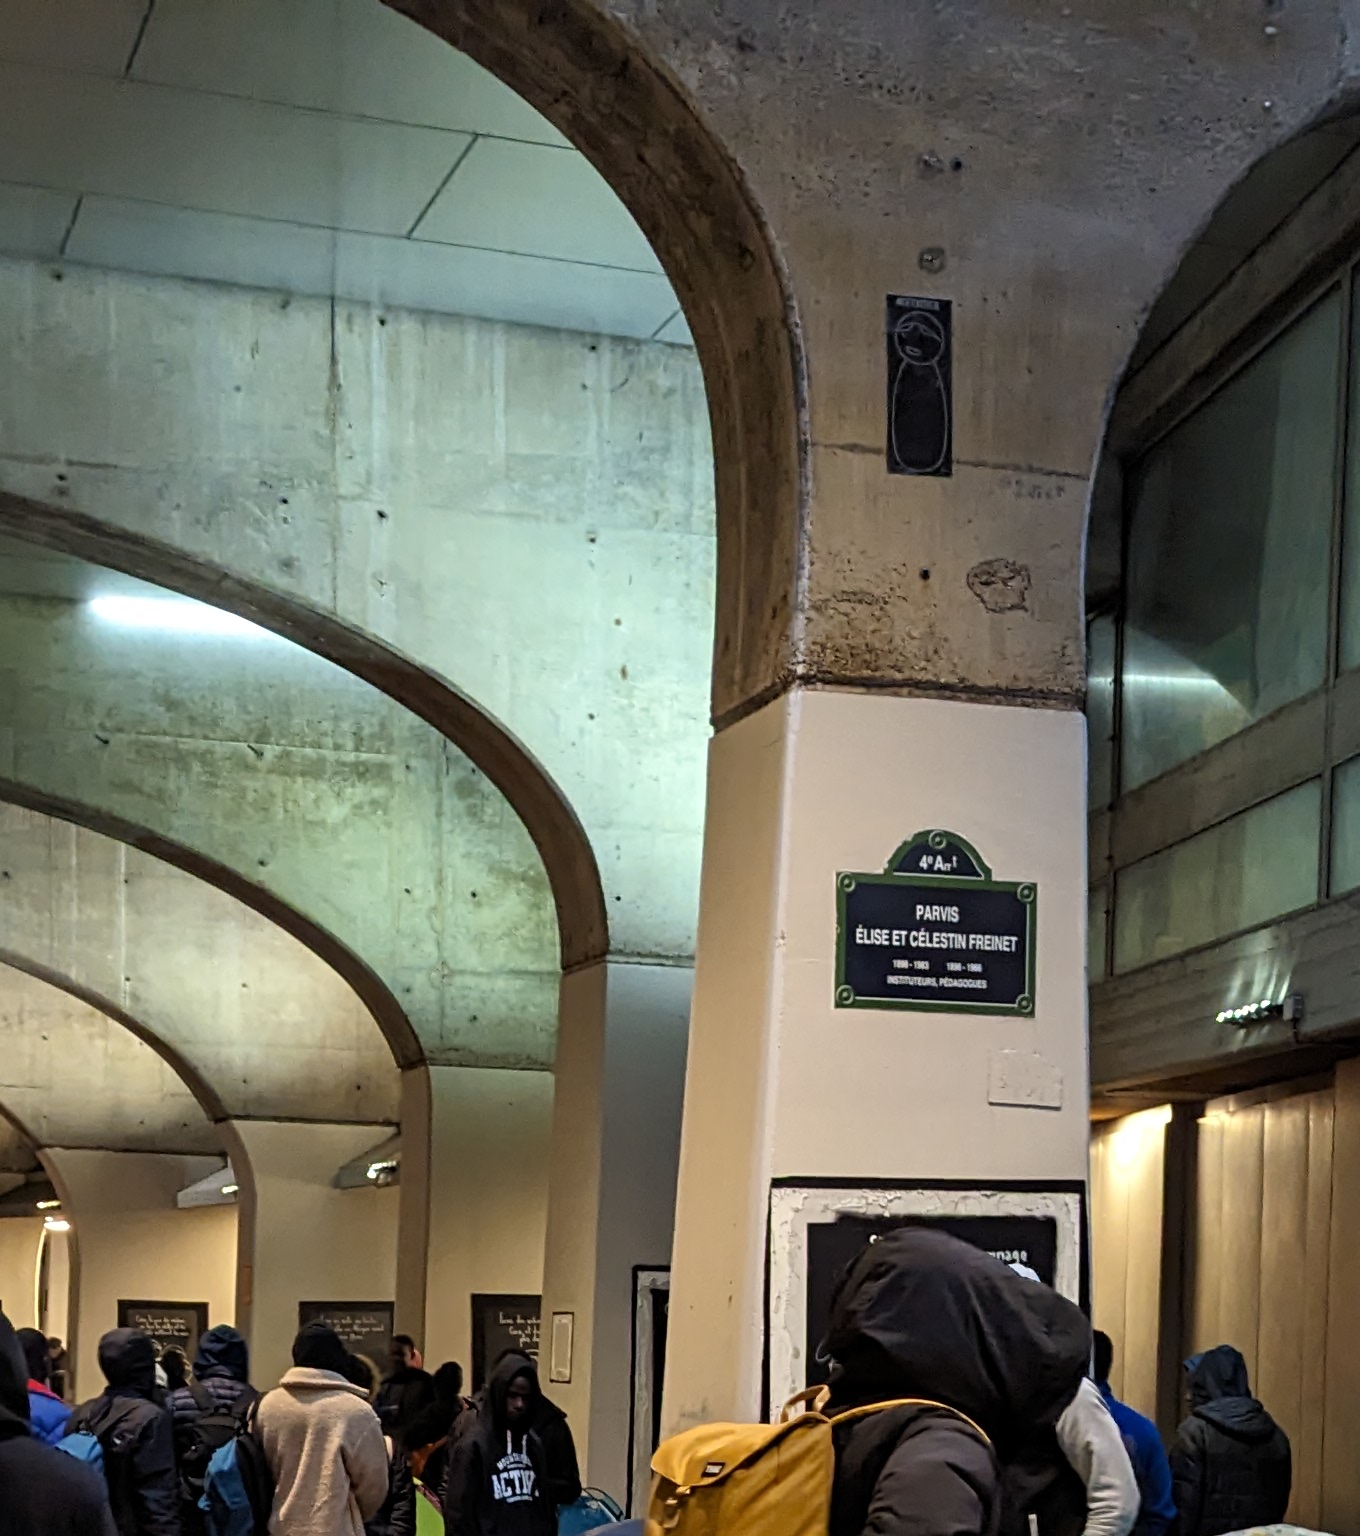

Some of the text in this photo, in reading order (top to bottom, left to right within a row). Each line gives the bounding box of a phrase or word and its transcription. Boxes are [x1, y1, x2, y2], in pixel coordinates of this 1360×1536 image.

[915, 905, 960, 923] PARVIS
[855, 924, 1018, 952] ÉLISE ET CÉLESTIN FREINET
